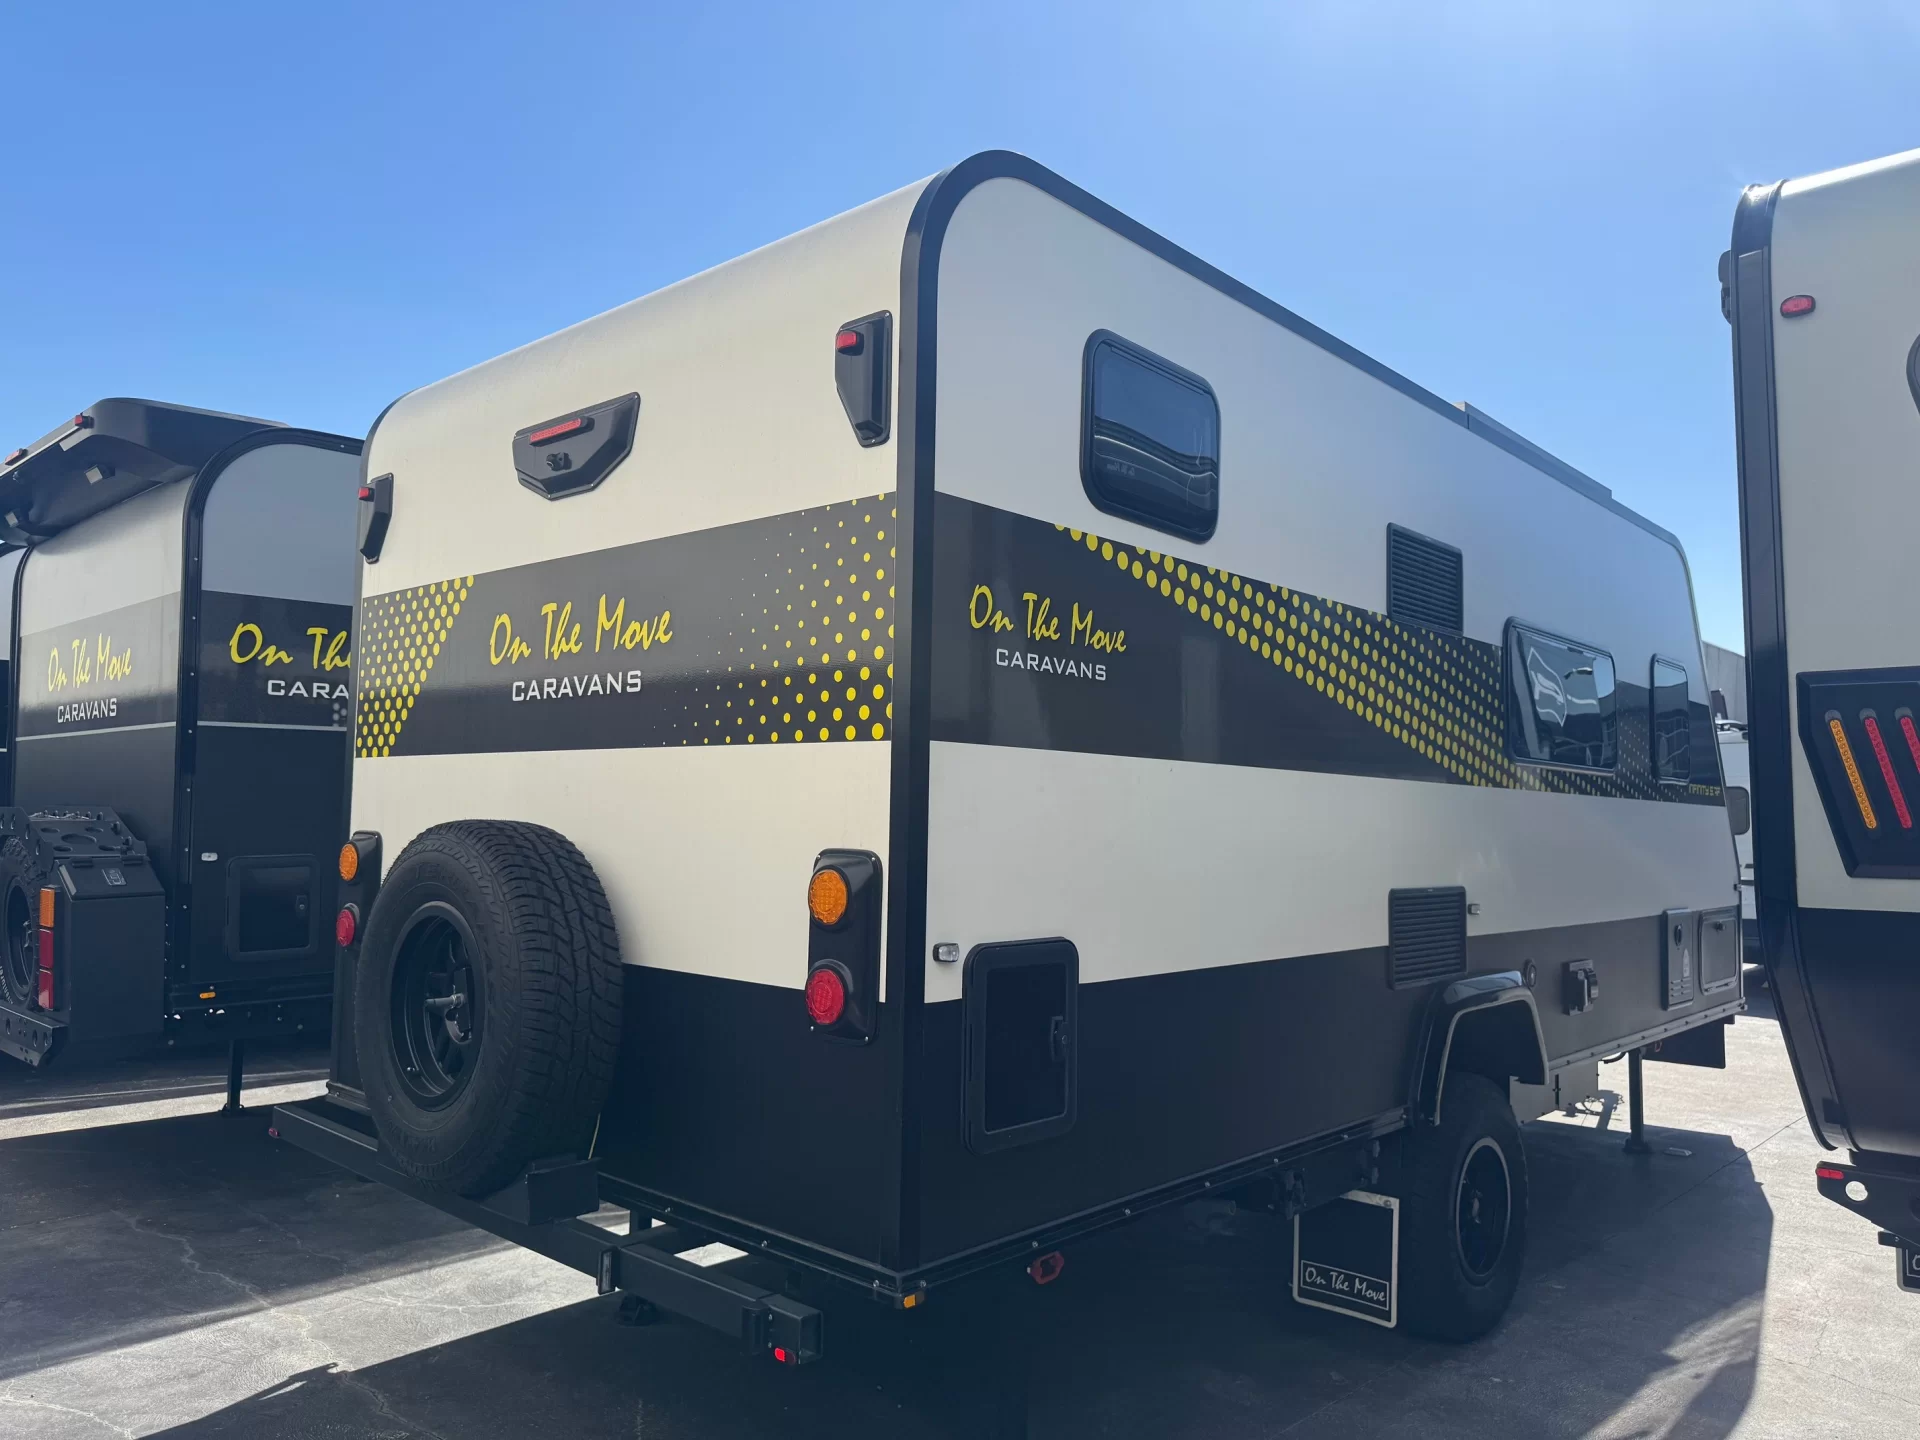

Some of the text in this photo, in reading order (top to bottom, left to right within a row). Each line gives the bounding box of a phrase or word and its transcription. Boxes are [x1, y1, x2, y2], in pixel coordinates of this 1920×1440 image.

[489, 593, 673, 665] On The Move
[969, 584, 1127, 654] On The Move
[48, 632, 132, 692] On The Move
[228, 622, 351, 672] On Th
[996, 648, 1107, 681] CARAVANS
[512, 670, 642, 702] CARAVANS
[57, 697, 117, 723] CARAVANS
[1305, 1267, 1386, 1301] On The Move
